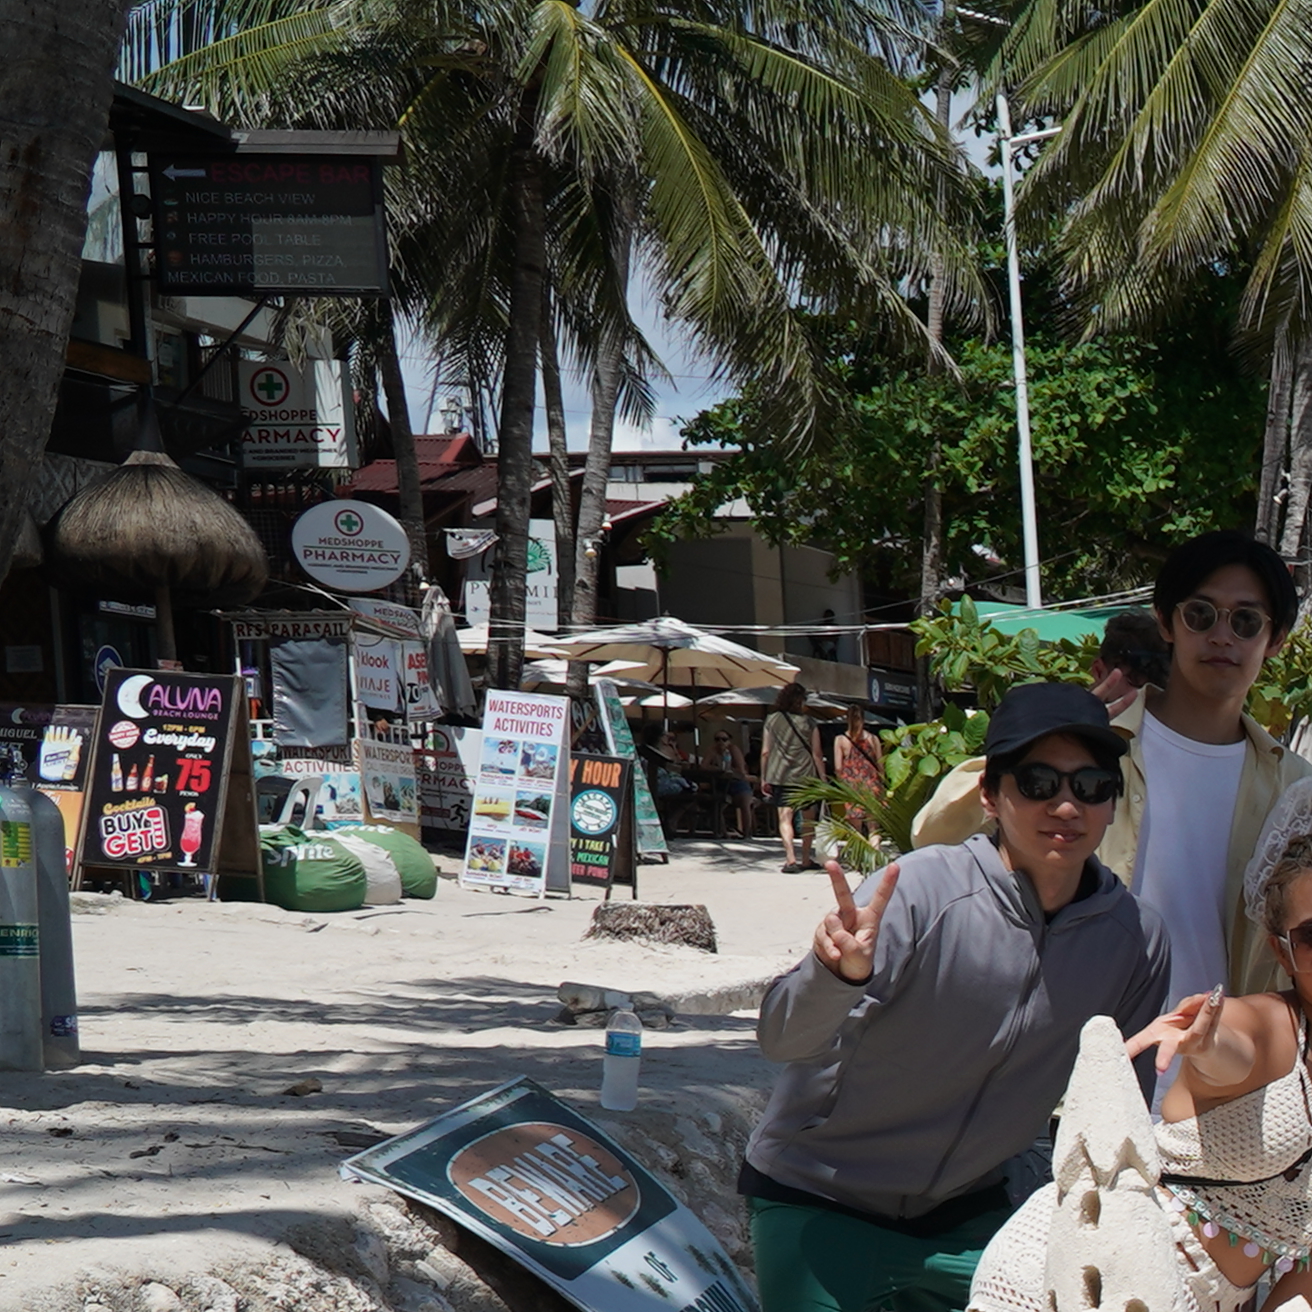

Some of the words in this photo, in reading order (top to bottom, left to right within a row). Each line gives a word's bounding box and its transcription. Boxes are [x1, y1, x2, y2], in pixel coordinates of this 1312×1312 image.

[210, 162, 311, 184] ESCAPE
[319, 164, 371, 184] BAR
[185, 192, 219, 204] NICE
[224, 192, 274, 204] BEACH
[278, 193, 316, 204] VIEW
[186, 213, 236, 224] HAPPY
[240, 214, 283, 225] HOUR
[188, 233, 226, 245] FREE
[231, 234, 272, 245] POOL
[277, 234, 321, 246] TABLE
[189, 254, 299, 266] HAMBURGERS,
[302, 255, 348, 268] PIZZA,
[167, 271, 233, 283] MEXICAN
[288, 273, 336, 284] PASTA
[240, 408, 317, 421] EDSHOPPE
[242, 428, 341, 444] ARMACY
[318, 537, 384, 548] MEDSHOPPE
[303, 549, 401, 564] PHARMACY
[148, 684, 222, 712] ALUNA
[152, 709, 181, 717] BEACH
[183, 710, 219, 720] LOUNGE
[488, 699, 564, 720] WATERSPORTS
[493, 717, 554, 737] ACTIVITIES
[143, 728, 216, 753] Everyday
[363, 745, 411, 764] WATERSPOR
[284, 760, 361, 773] ACTIVITIES
[582, 759, 622, 788] HOUR
[175, 758, 213, 793] 75
[102, 796, 156, 815] Cocktails
[104, 812, 144, 835] BUY
[106, 830, 151, 855] GET
[584, 839, 604, 852] TAKE
[267, 843, 336, 867] Sprite
[576, 851, 609, 866] MEXICAN
[571, 863, 586, 876] EER
[467, 1133, 629, 1237] BEWARE
[643, 1251, 678, 1283] OF
